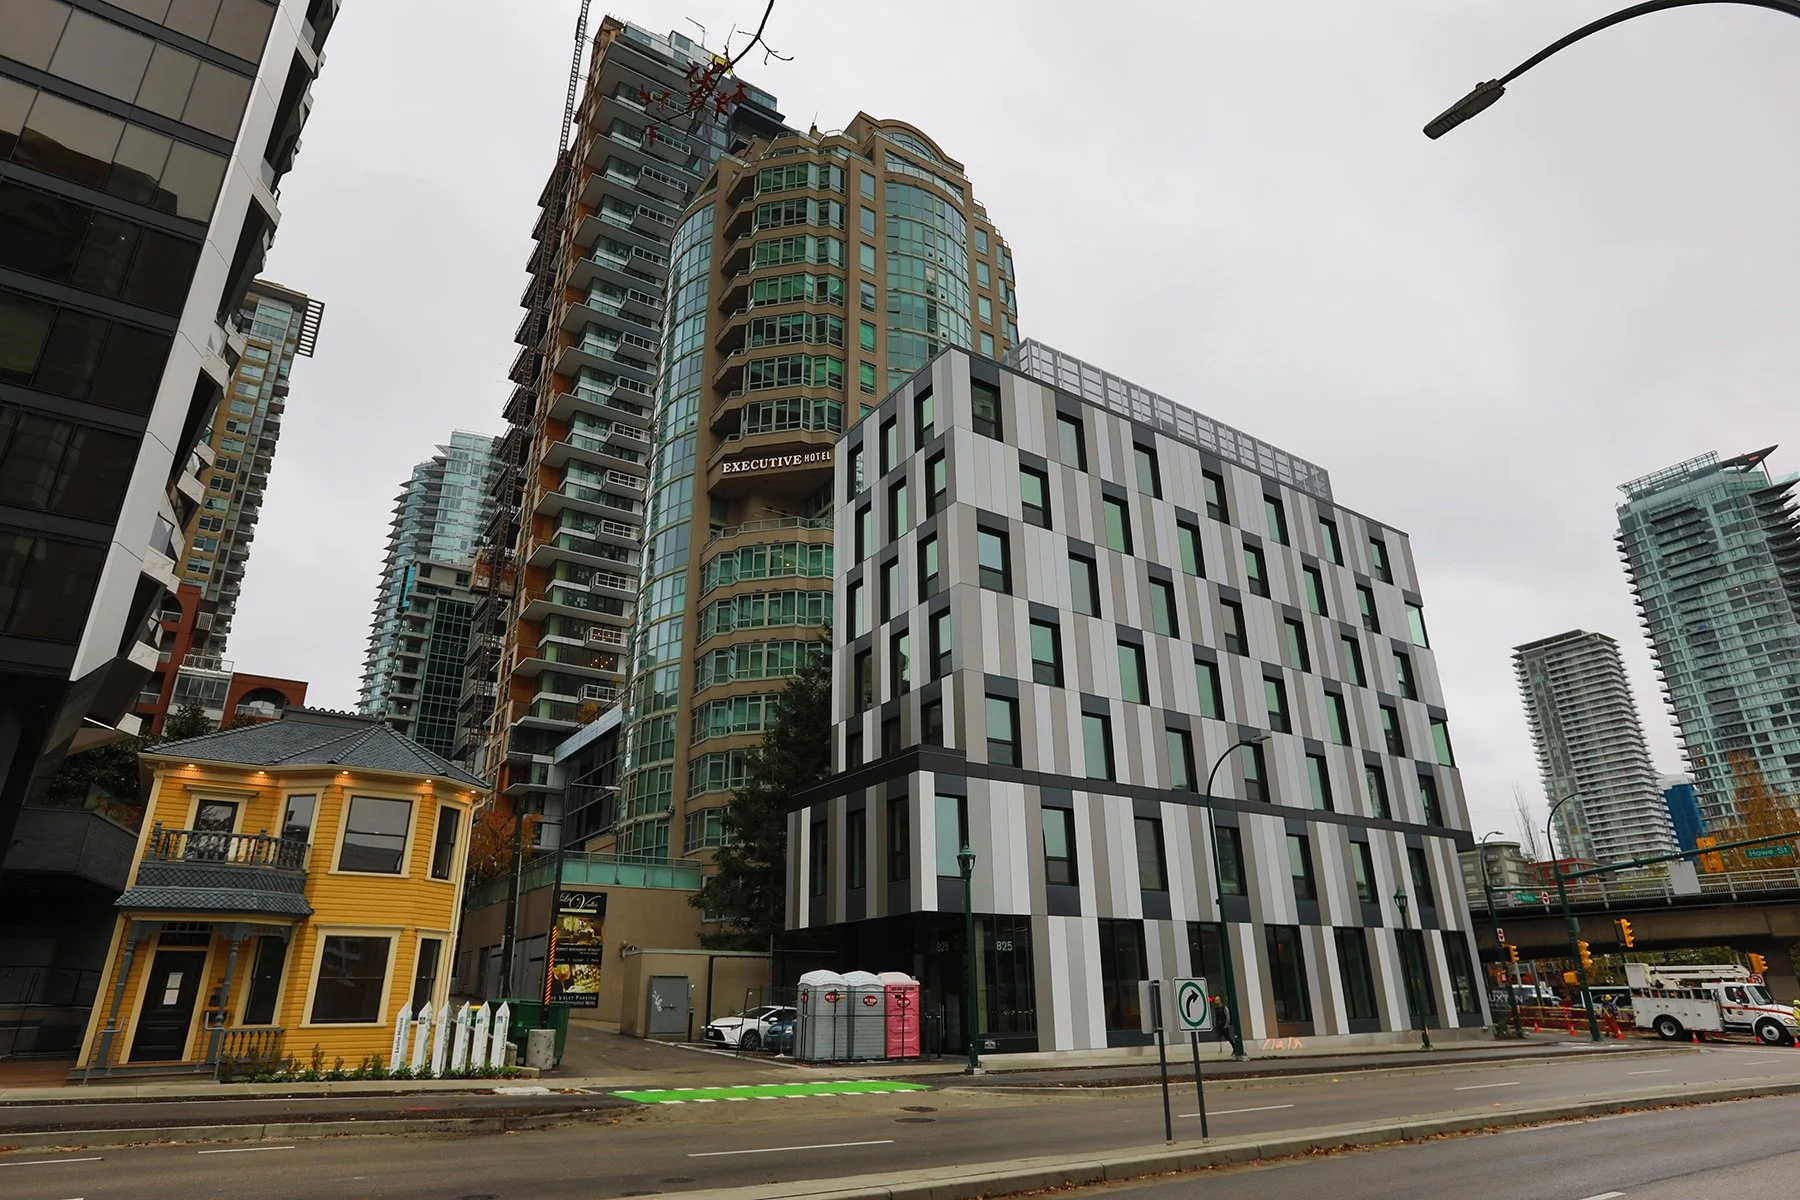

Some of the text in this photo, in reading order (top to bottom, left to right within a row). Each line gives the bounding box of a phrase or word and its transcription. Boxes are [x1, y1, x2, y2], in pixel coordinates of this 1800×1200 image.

[722, 451, 831, 473] EXECUTIVE HOTEL
[1748, 846, 1789, 857] Howe St
[936, 941, 950, 952] 825
[996, 941, 1013, 951] 825
